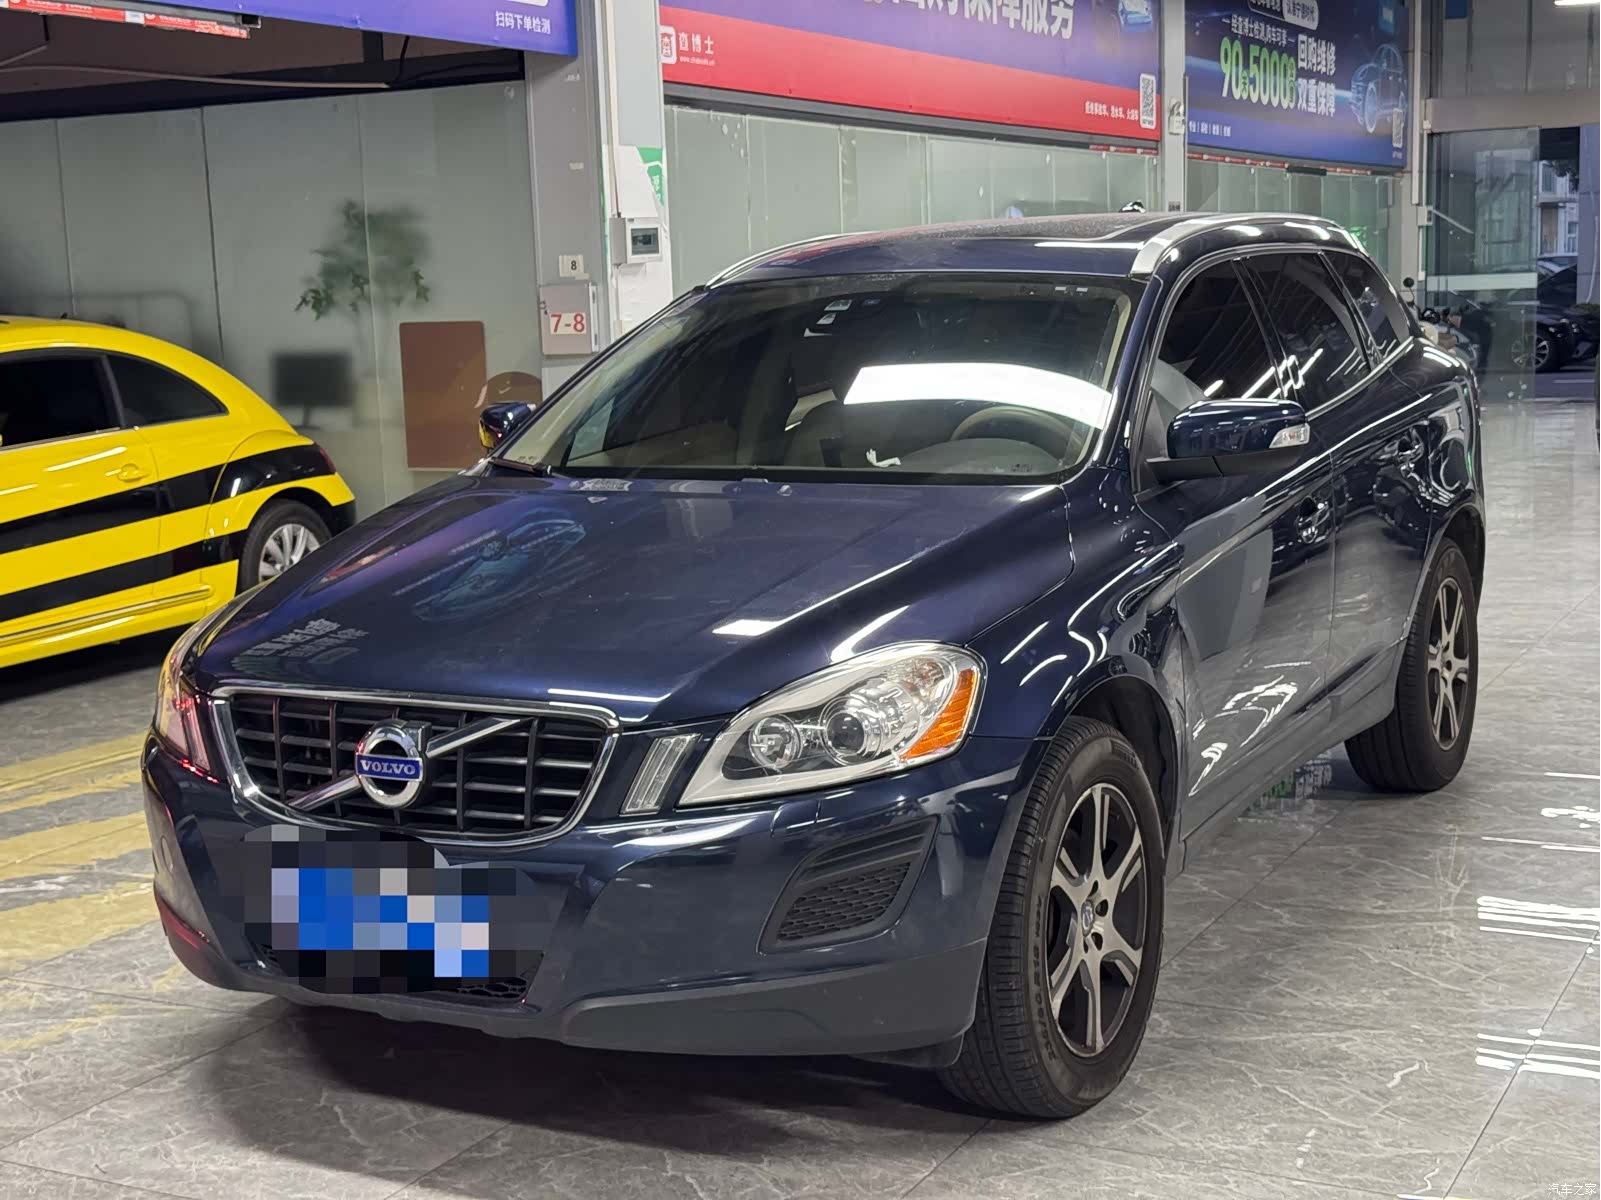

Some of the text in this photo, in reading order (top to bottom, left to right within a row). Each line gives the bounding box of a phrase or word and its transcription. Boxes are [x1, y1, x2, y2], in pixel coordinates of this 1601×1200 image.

[495, 10, 551, 34] 扫码下单检测
[1297, 33, 1336, 76] 回购维修
[1297, 77, 1336, 117] 双重保障
[570, 260, 578, 271] 8
[550, 313, 585, 333] 7-8
[359, 759, 416, 775] VOLVO
